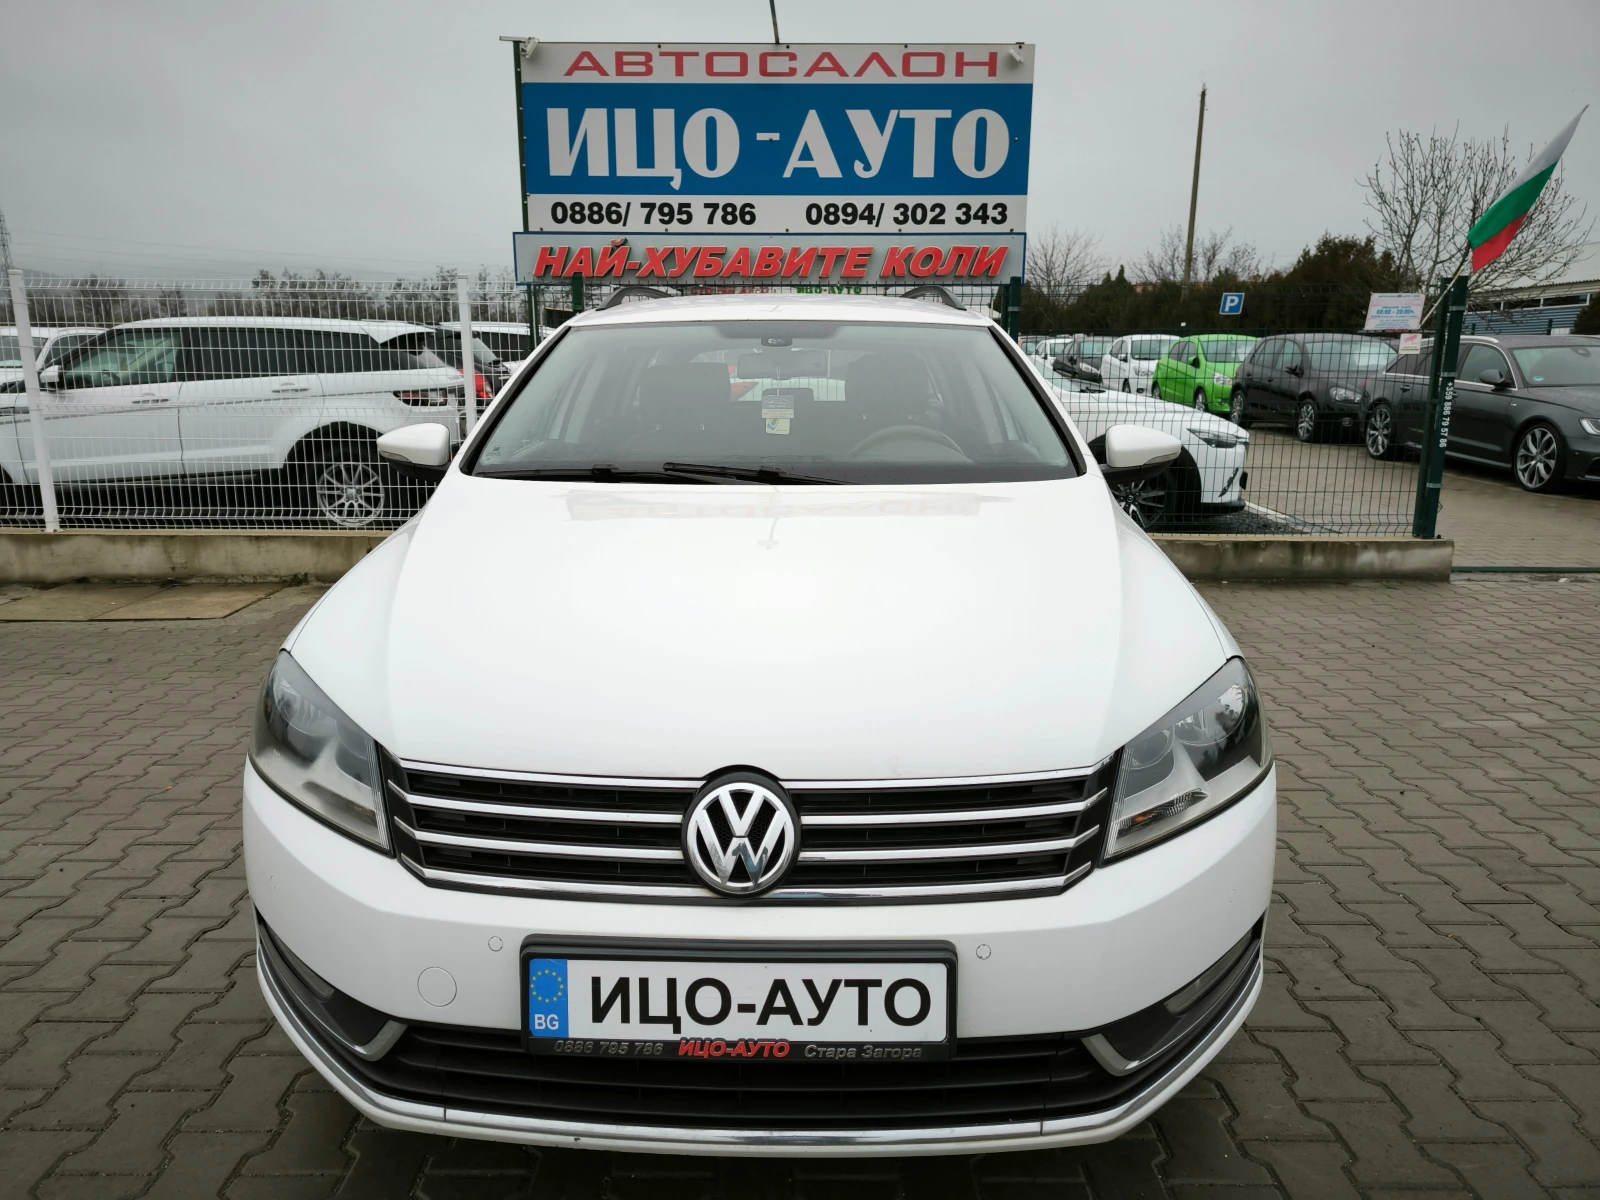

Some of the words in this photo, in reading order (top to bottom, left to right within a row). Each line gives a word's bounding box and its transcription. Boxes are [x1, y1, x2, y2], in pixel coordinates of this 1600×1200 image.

[564, 50, 998, 77] АВТОСАЛОН
[551, 201, 630, 227] 0886/
[641, 203, 693, 225] 795
[704, 203, 757, 225] 786
[805, 203, 885, 227] 0894/
[892, 203, 946, 225] 302
[954, 203, 1008, 225] 343
[533, 239, 875, 279] НАЙ-ХУБАВИТЕ
[879, 245, 1010, 278] КОЛИ
[1224, 295, 1239, 312] P
[1442, 401, 1452, 416] 886
[1441, 417, 1450, 426] 79
[1440, 427, 1449, 437] 57
[1439, 438, 1448, 448] 86
[591, 976, 932, 1034] ИЦО-АУТО
[534, 1014, 560, 1030] BG
[553, 1040, 594, 1053] 0886
[599, 1041, 629, 1055] 795
[634, 1042, 664, 1055] 786
[678, 1038, 790, 1059] ИЦО-АУТО
[804, 1045, 857, 1060] Стара
[861, 1045, 923, 1060] Загора
